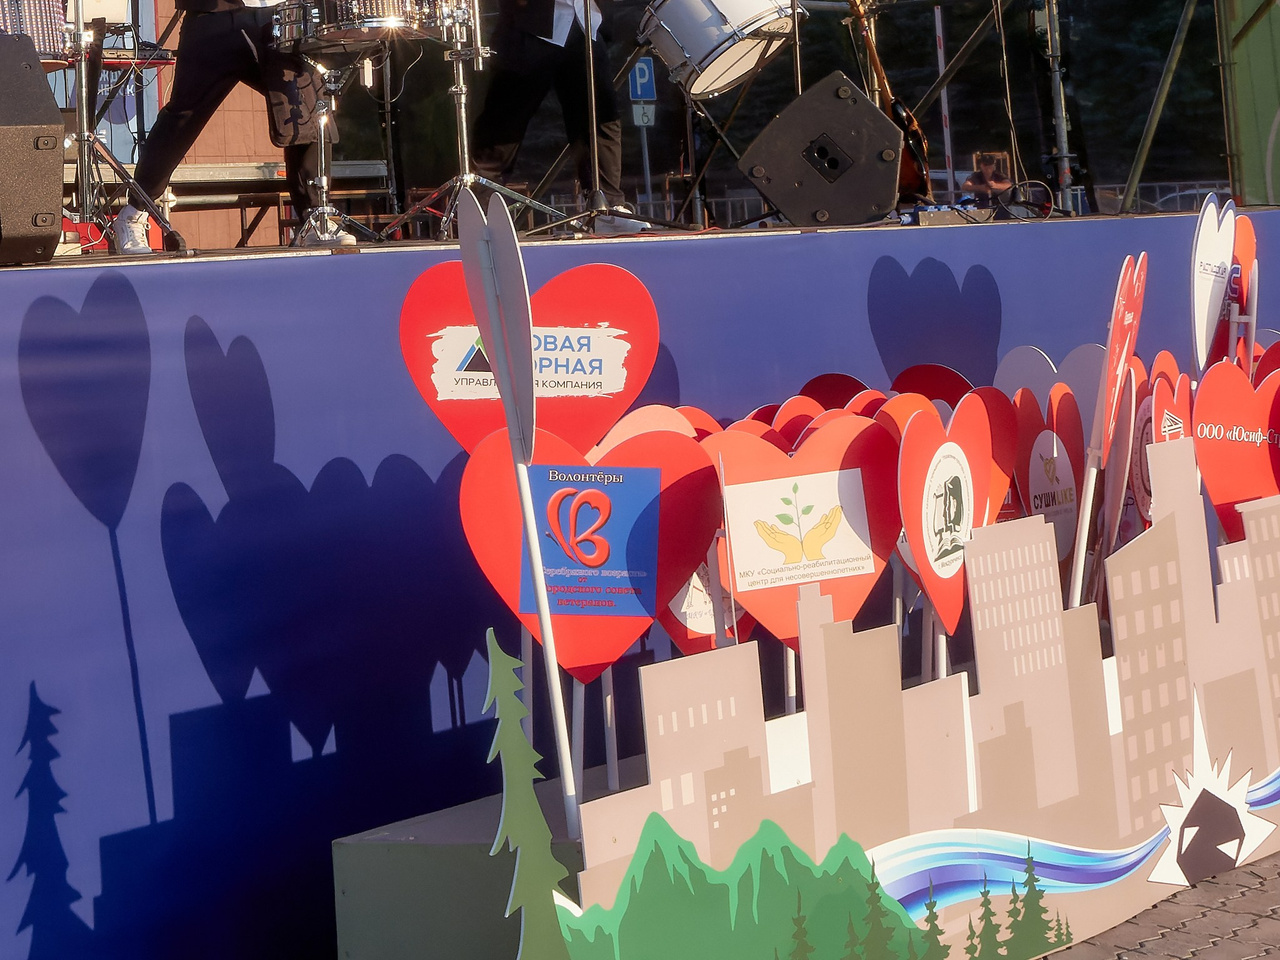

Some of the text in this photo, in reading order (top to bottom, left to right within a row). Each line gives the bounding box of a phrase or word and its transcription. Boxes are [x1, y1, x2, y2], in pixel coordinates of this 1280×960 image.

[541, 380, 603, 390] КОМПАНИЯ
[1197, 422, 1224, 440] ООО
[548, 469, 624, 485] Волонтёры
[739, 570, 755, 579] МКУ
[748, 577, 769, 587] центр
[770, 576, 784, 585] для
